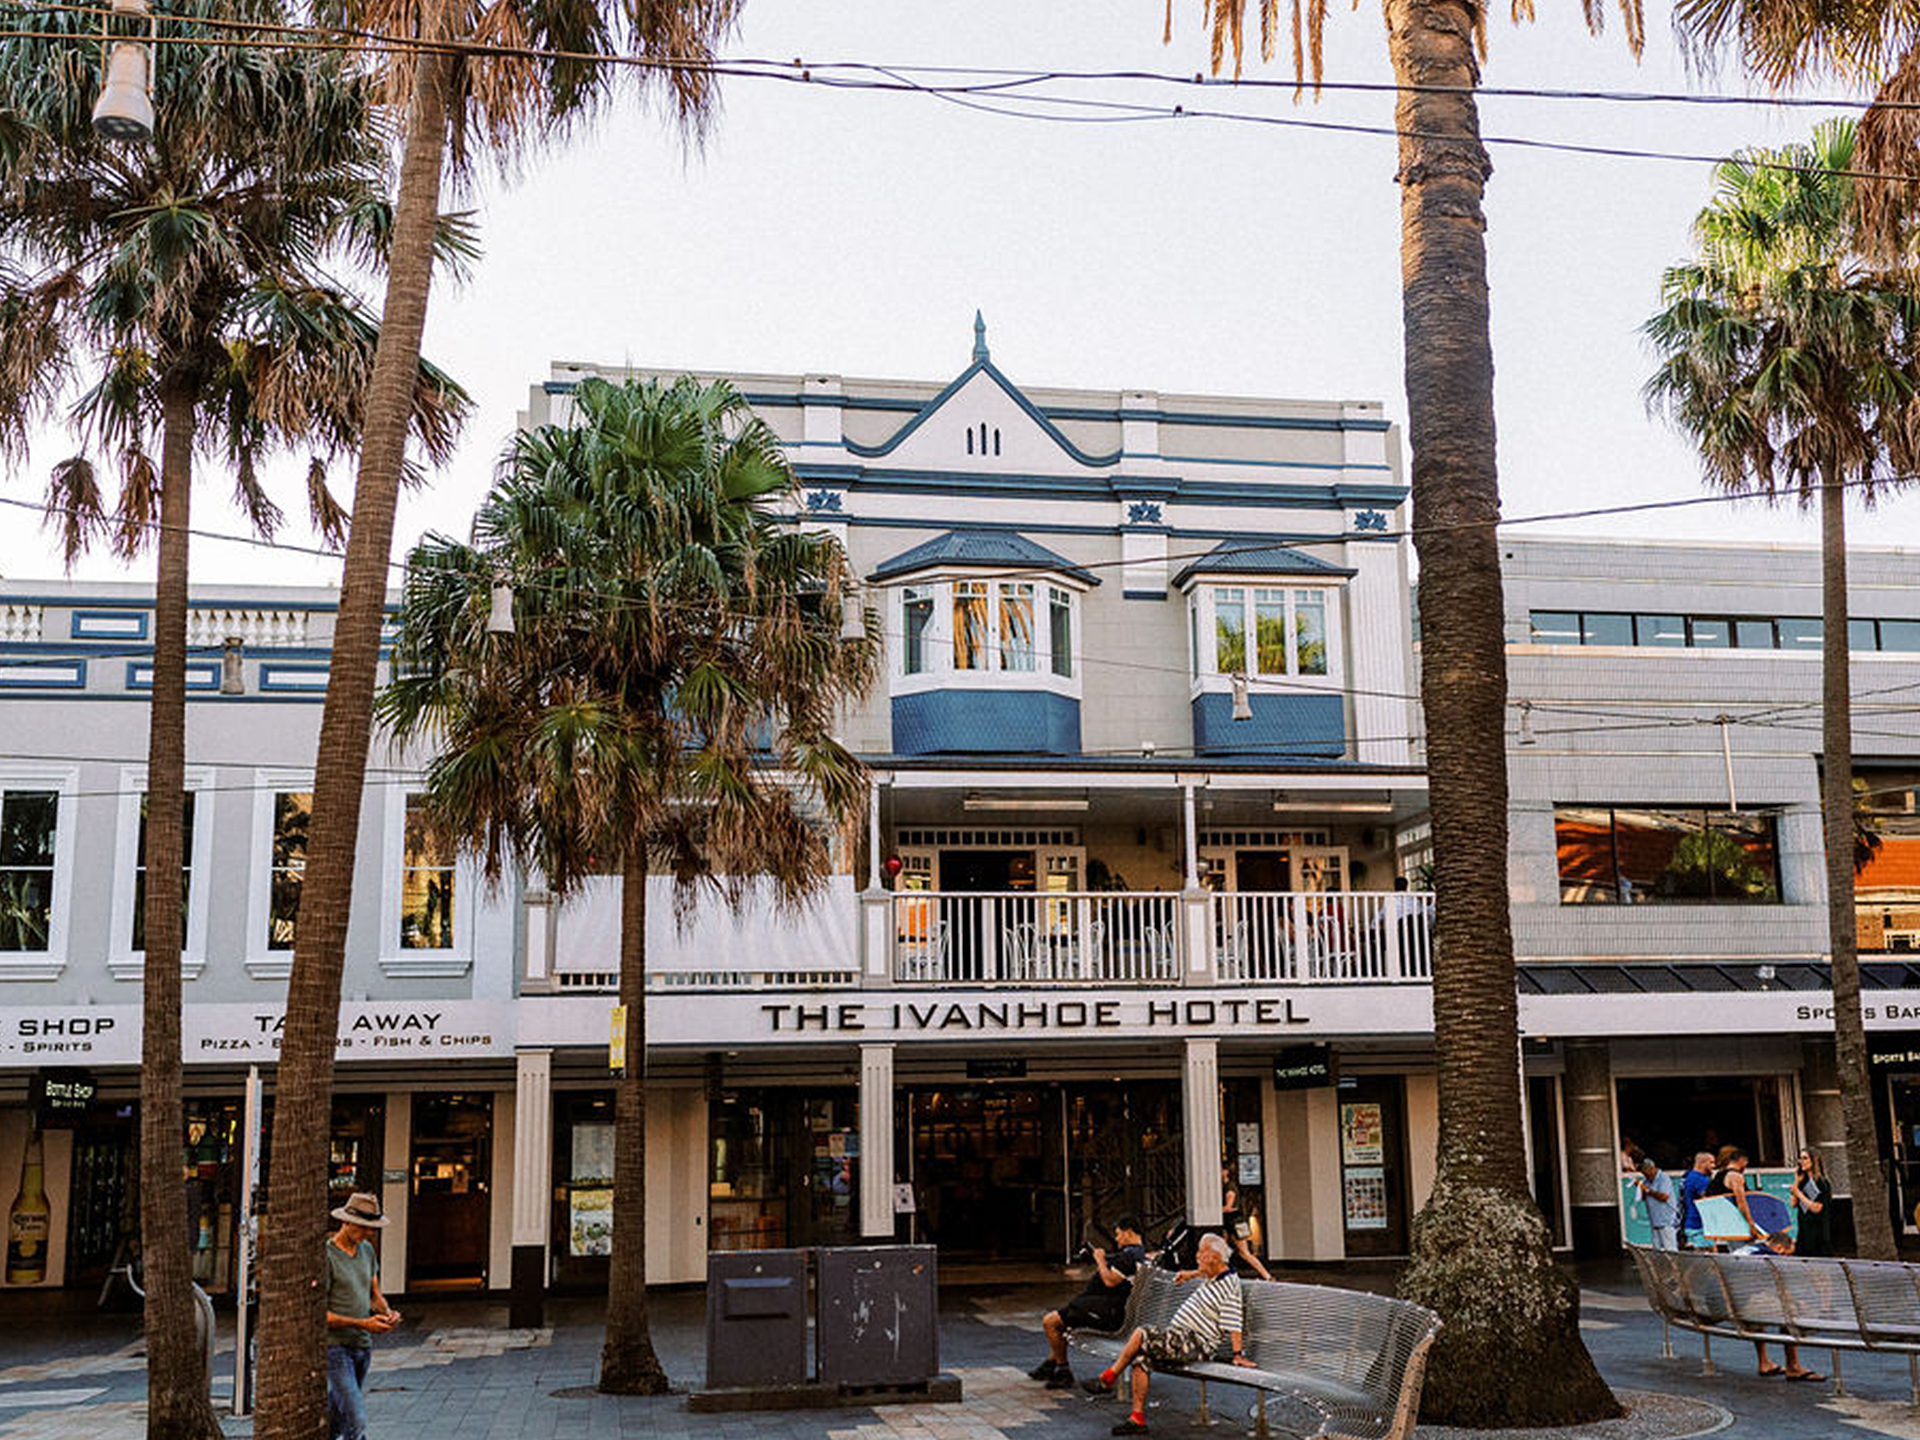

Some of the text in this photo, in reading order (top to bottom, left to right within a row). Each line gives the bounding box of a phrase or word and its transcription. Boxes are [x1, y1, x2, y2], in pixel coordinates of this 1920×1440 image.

[352, 1013, 441, 1031] AWAY
[762, 999, 1310, 1031] THE IVANHOE HOTEL
[18, 1018, 115, 1036] SHOP
